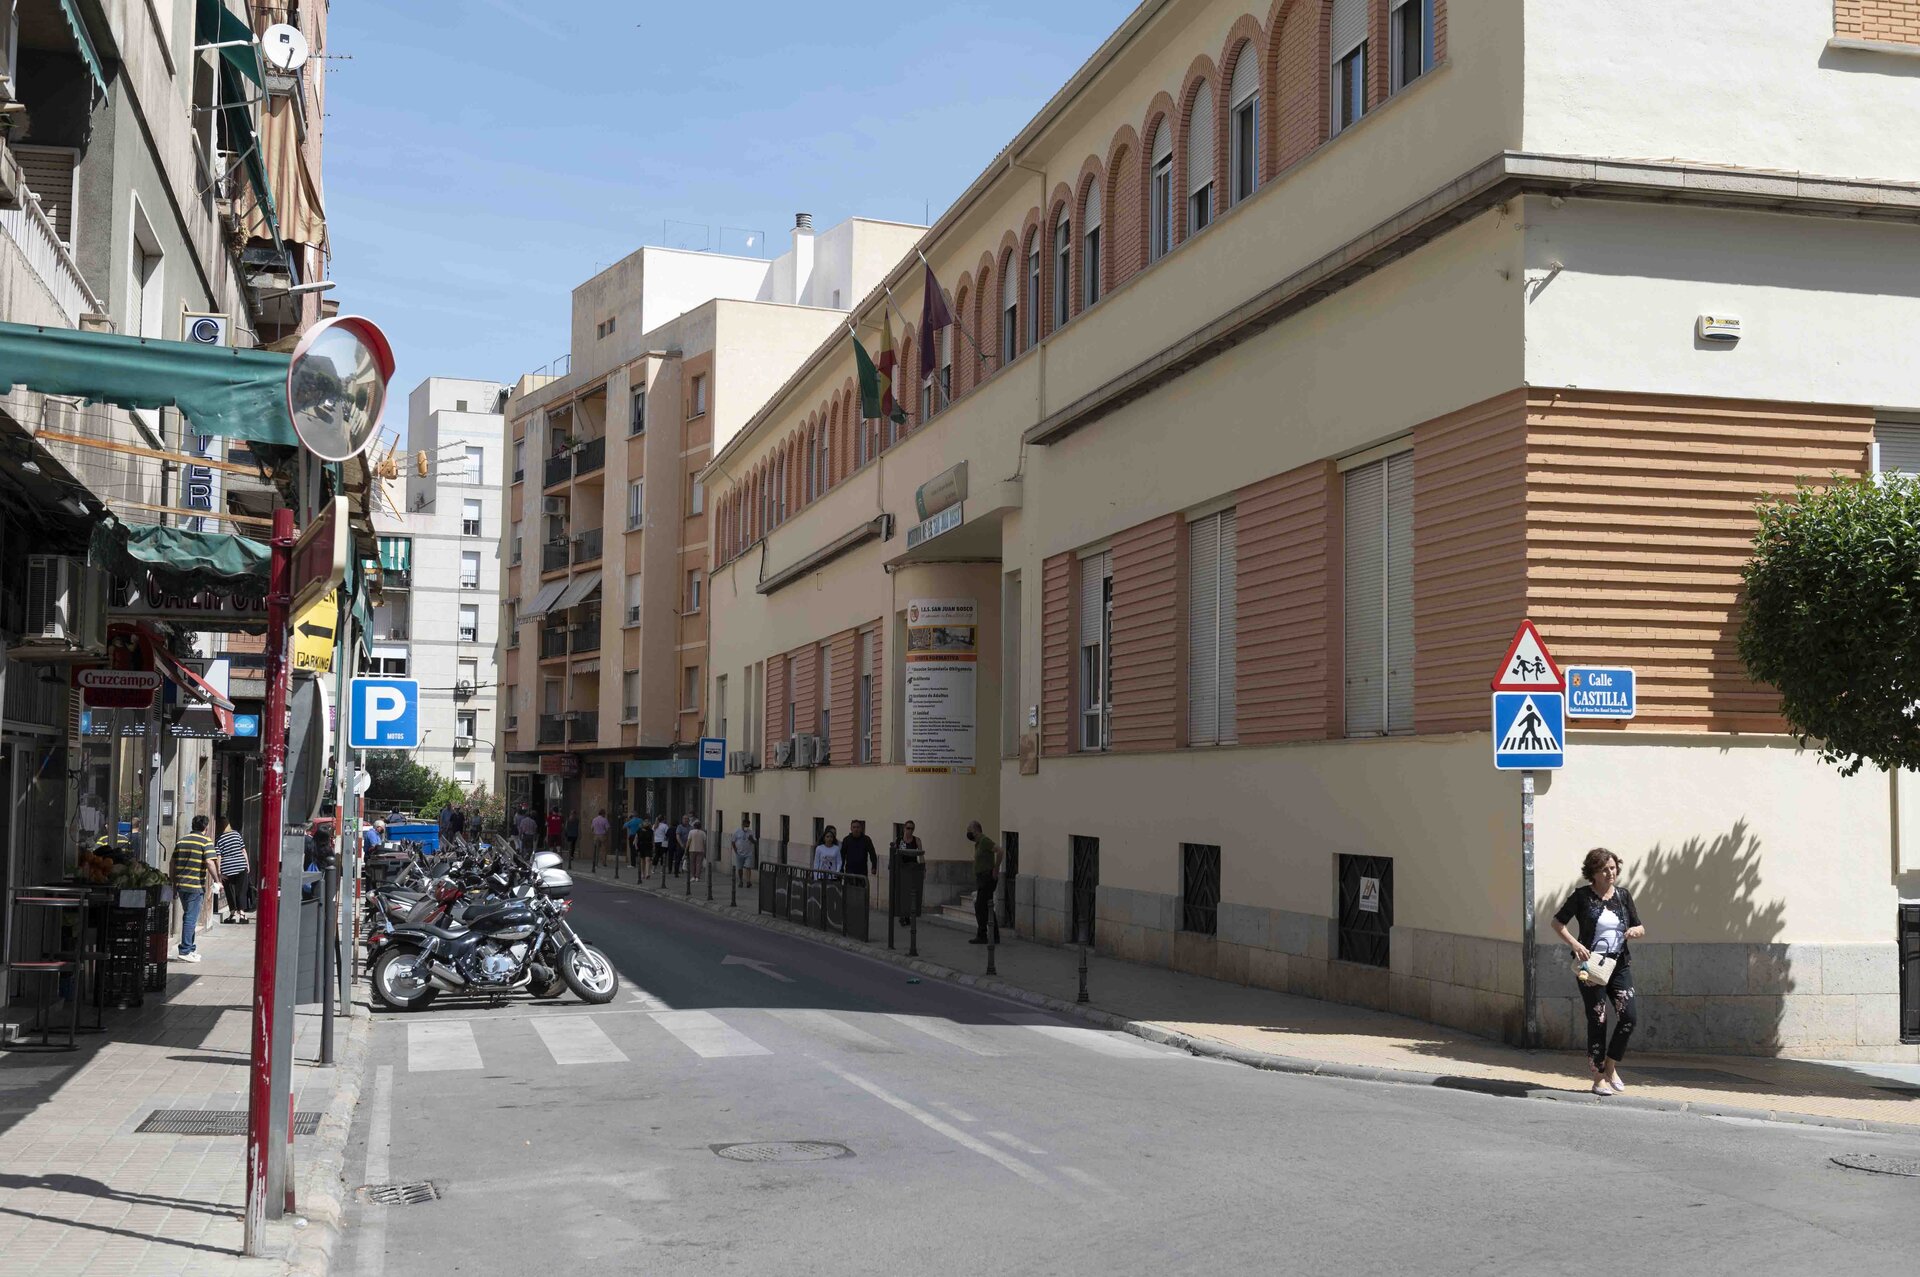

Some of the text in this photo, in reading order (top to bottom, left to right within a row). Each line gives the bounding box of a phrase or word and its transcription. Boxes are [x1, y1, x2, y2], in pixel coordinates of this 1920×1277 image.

[296, 651, 330, 670] PARKING
[84, 672, 154, 687] Cruzcampo
[1588, 672, 1613, 687] Calle
[1573, 690, 1628, 707] CASTILLA
[364, 686, 407, 740] P
[386, 732, 405, 740] MOTOS
